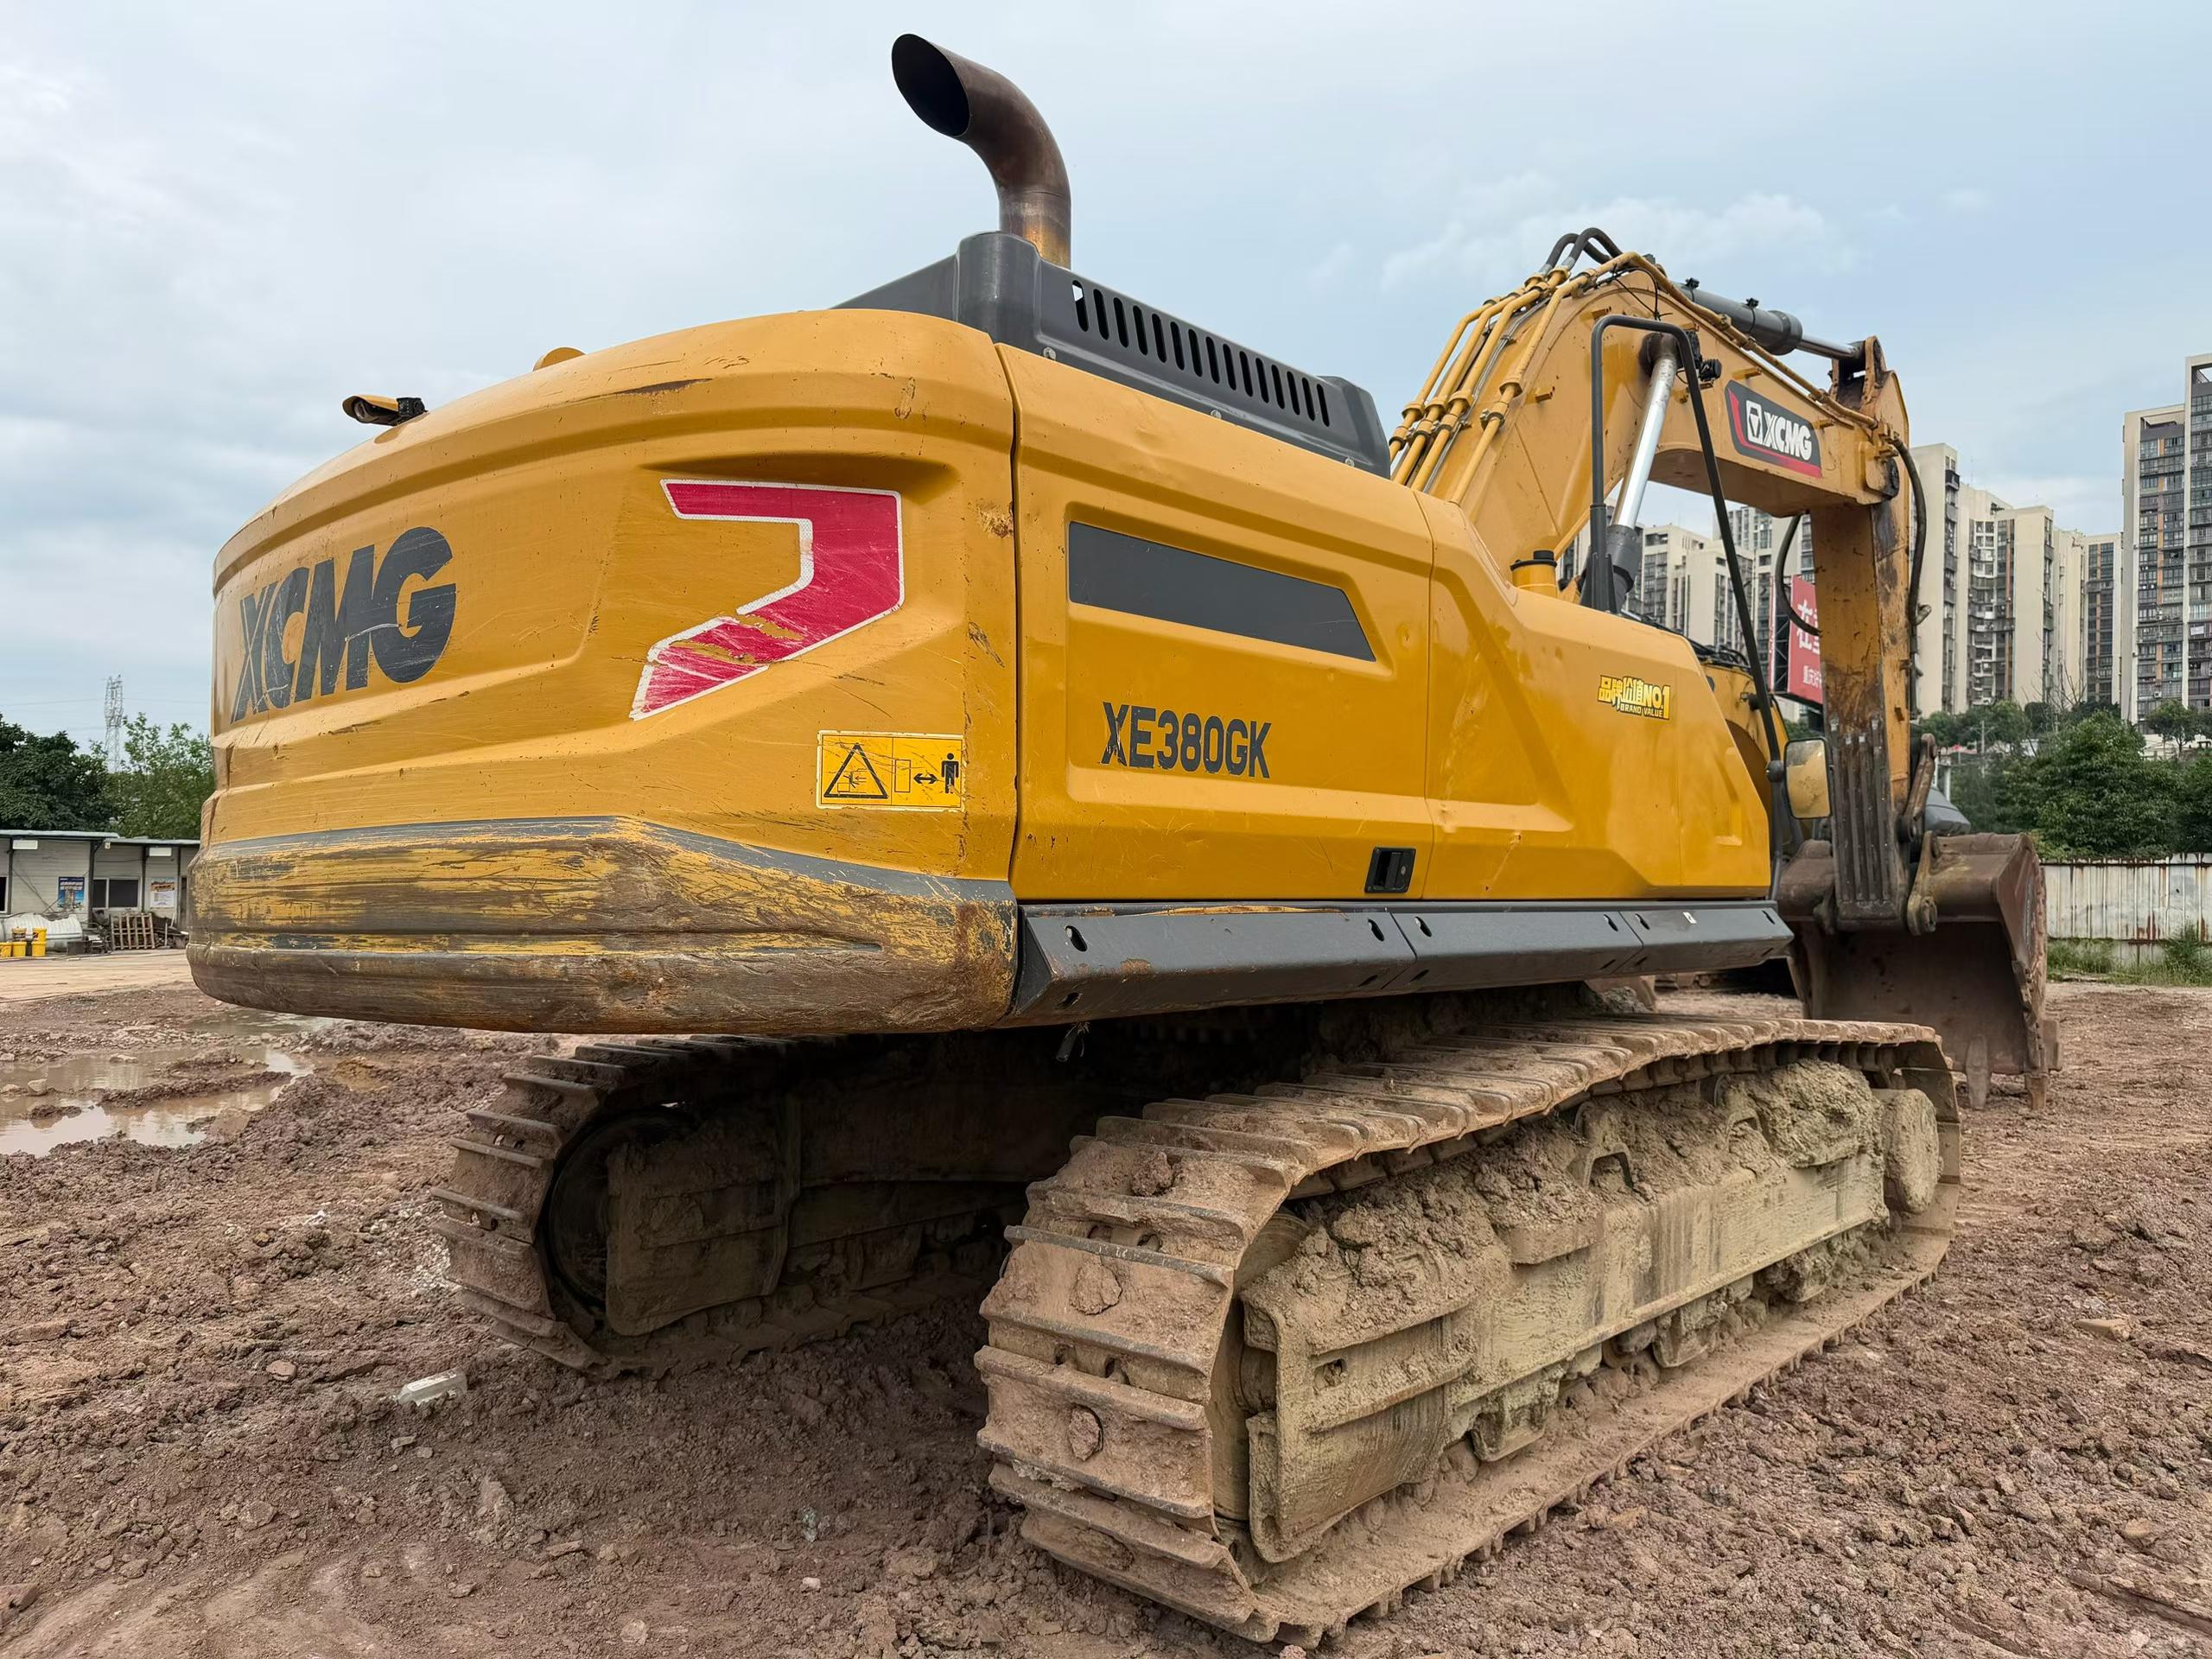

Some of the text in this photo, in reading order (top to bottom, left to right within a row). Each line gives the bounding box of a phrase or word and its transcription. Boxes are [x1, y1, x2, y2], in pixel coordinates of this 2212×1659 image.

[1763, 410, 1812, 461] XCMG
[231, 526, 457, 724] XCMG
[1101, 702, 1272, 779] XE380GK
[1620, 703, 1663, 717] BRAND VALUE
